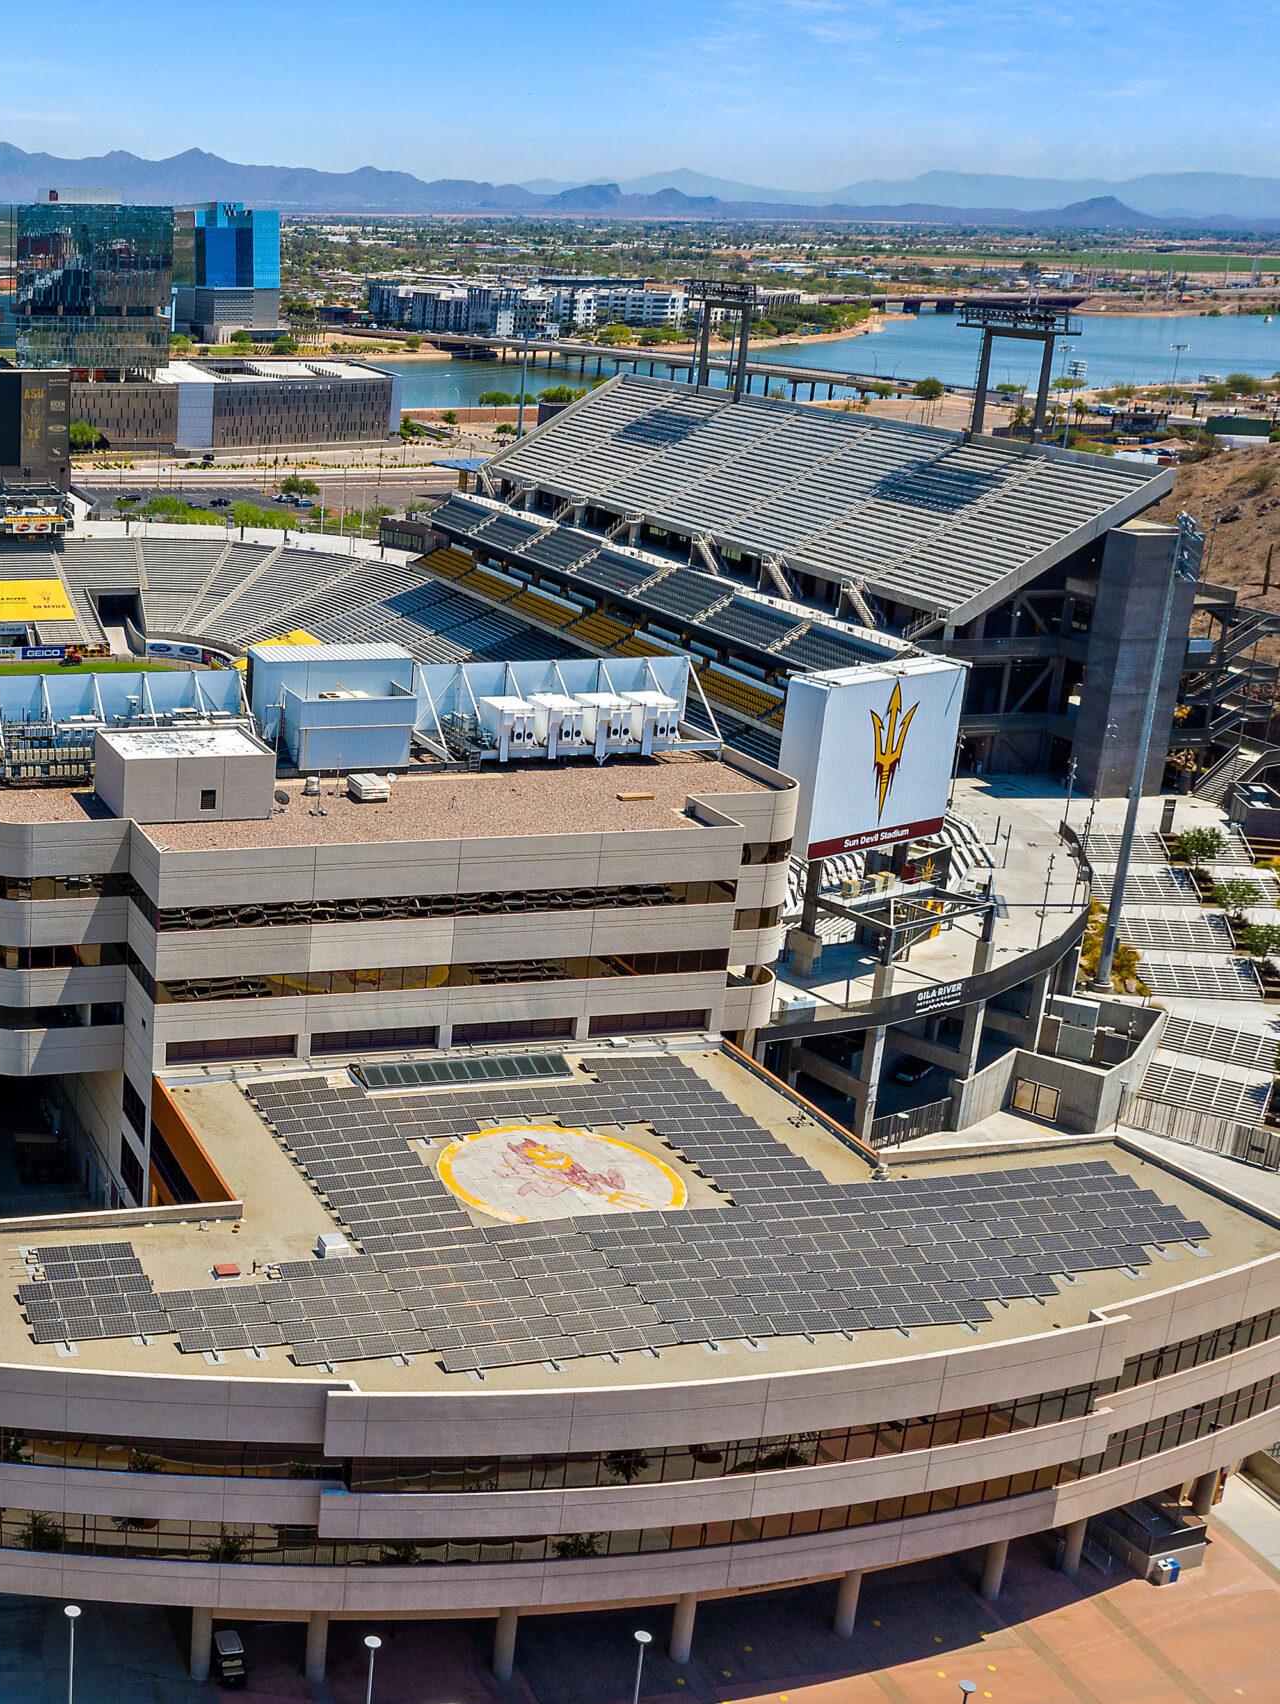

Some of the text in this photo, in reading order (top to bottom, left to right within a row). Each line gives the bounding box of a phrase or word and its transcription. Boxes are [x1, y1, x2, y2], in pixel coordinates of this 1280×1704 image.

[23, 388, 45, 399] ASU
[27, 649, 60, 657] GEICO
[844, 828, 909, 848] Sun Devil Stadium
[917, 983, 962, 1001] GILA RIVER
